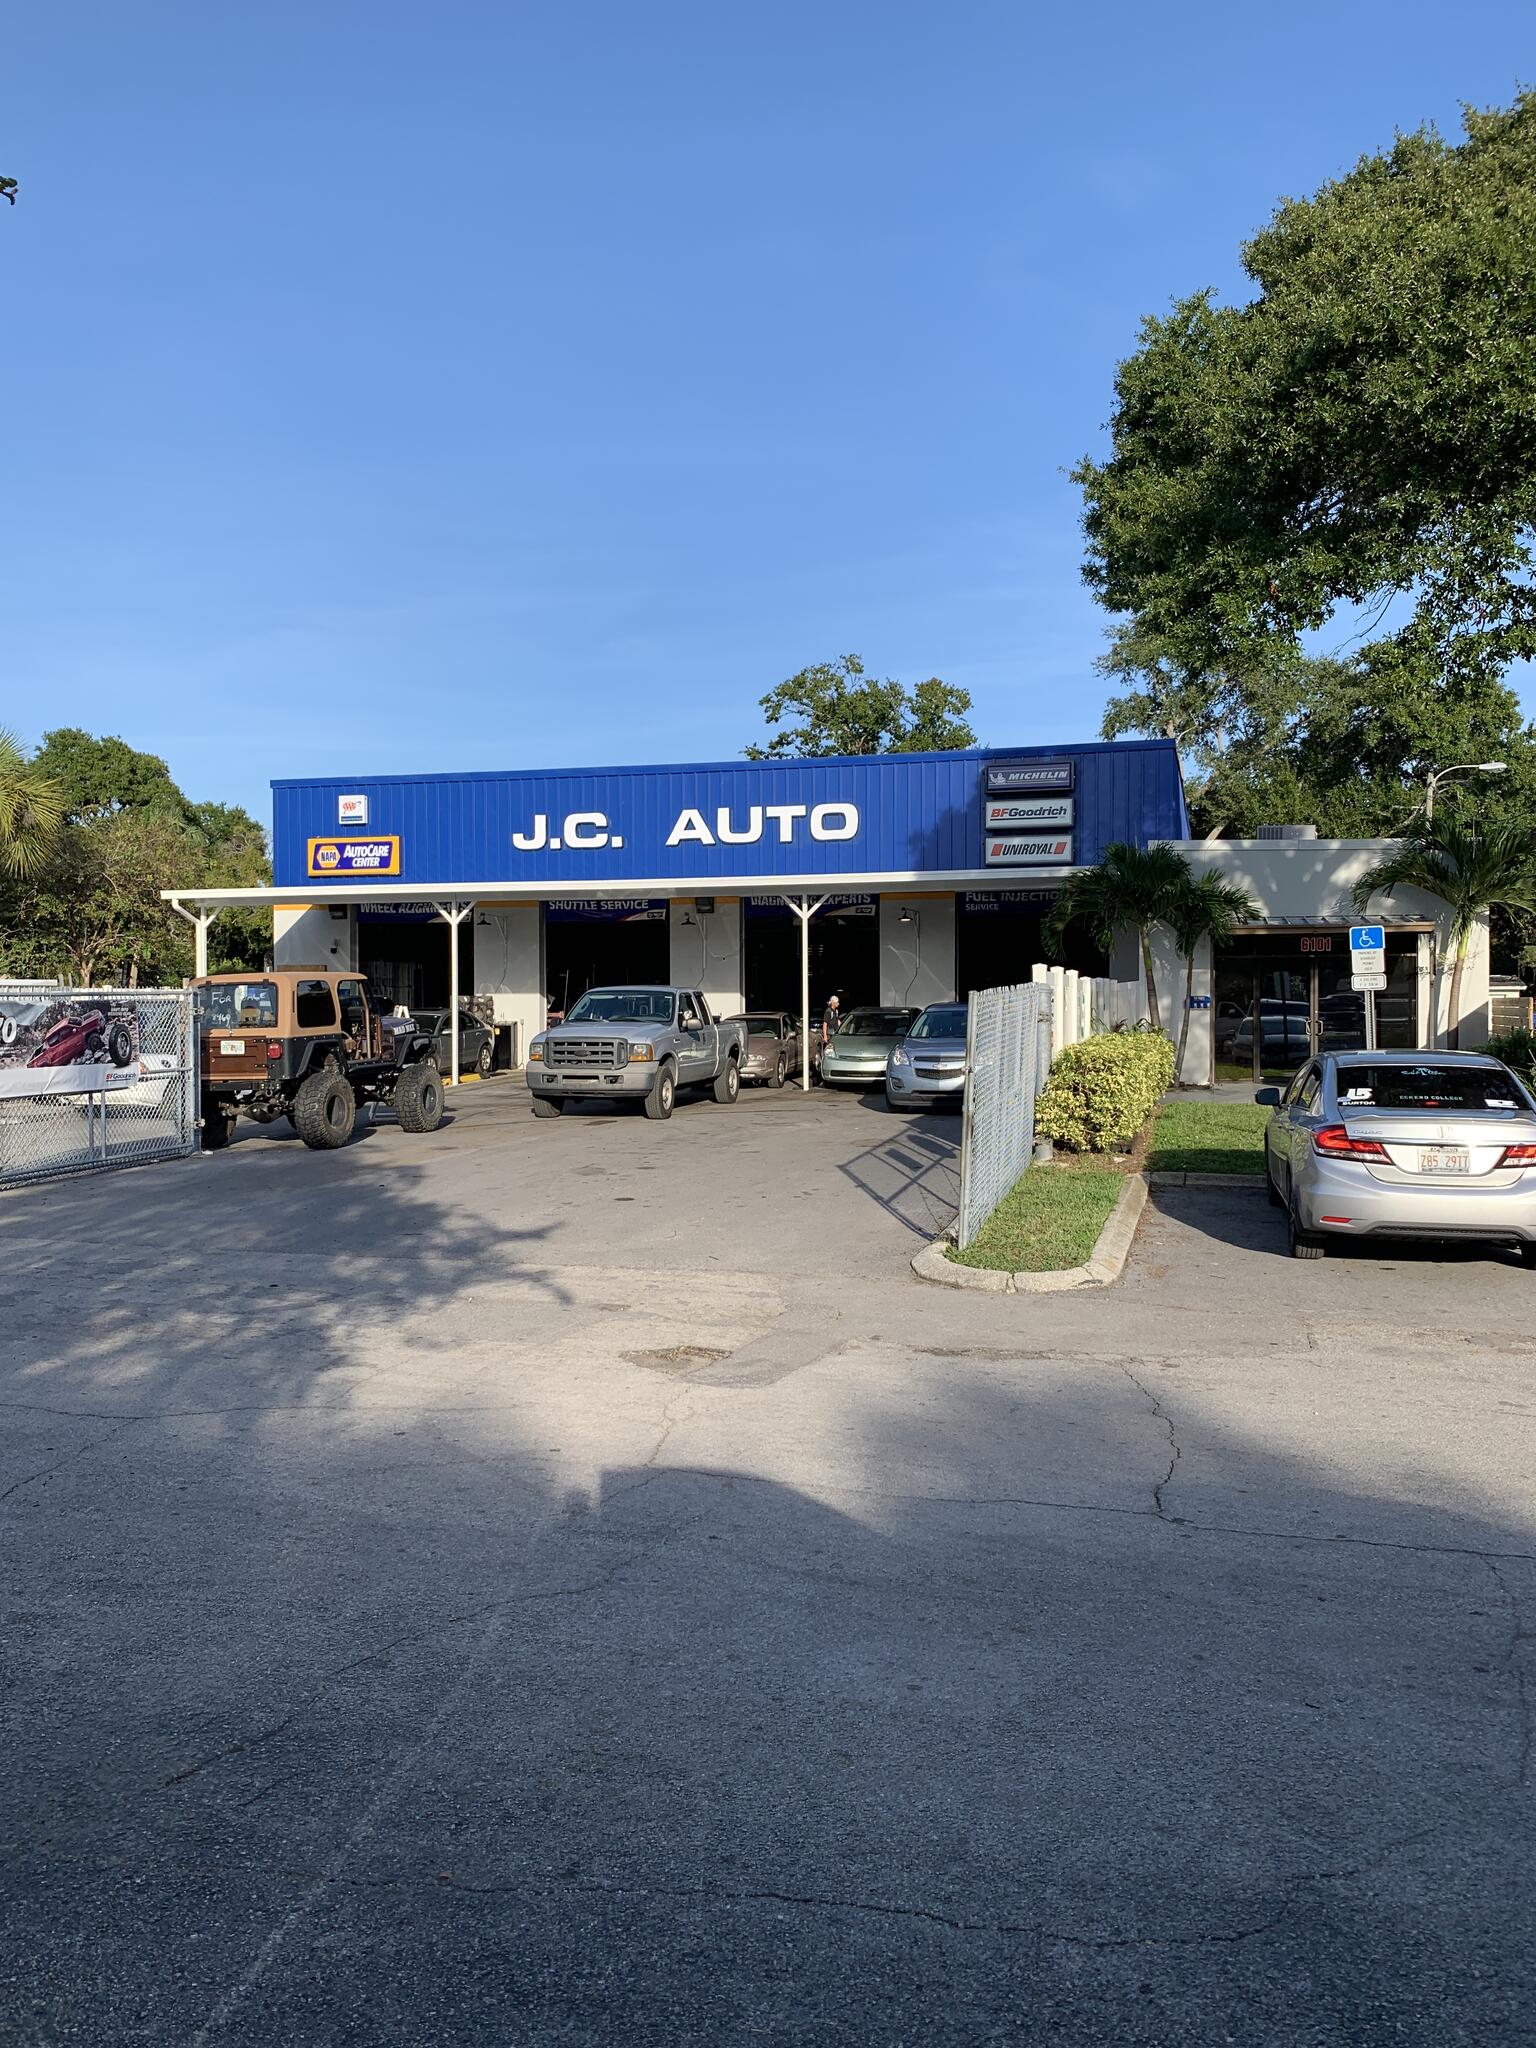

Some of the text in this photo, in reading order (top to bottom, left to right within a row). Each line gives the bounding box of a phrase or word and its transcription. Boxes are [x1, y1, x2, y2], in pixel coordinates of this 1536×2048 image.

[1008, 771, 1068, 781] MICHELIN
[991, 806, 1067, 818] BFGoodrich
[512, 803, 859, 851] J.C. AUTO
[1002, 843, 1053, 856] UNIROYAL
[320, 851, 337, 862] NAPA
[352, 858, 381, 868] CENTER
[966, 890, 1061, 902] FUEL INJECTIO
[360, 903, 396, 914] WHEEL
[549, 899, 649, 910] SHUTTLE SERVICE
[966, 903, 999, 911] SERVICE
[1301, 937, 1331, 952] 6101
[211, 991, 232, 1005] FOR
